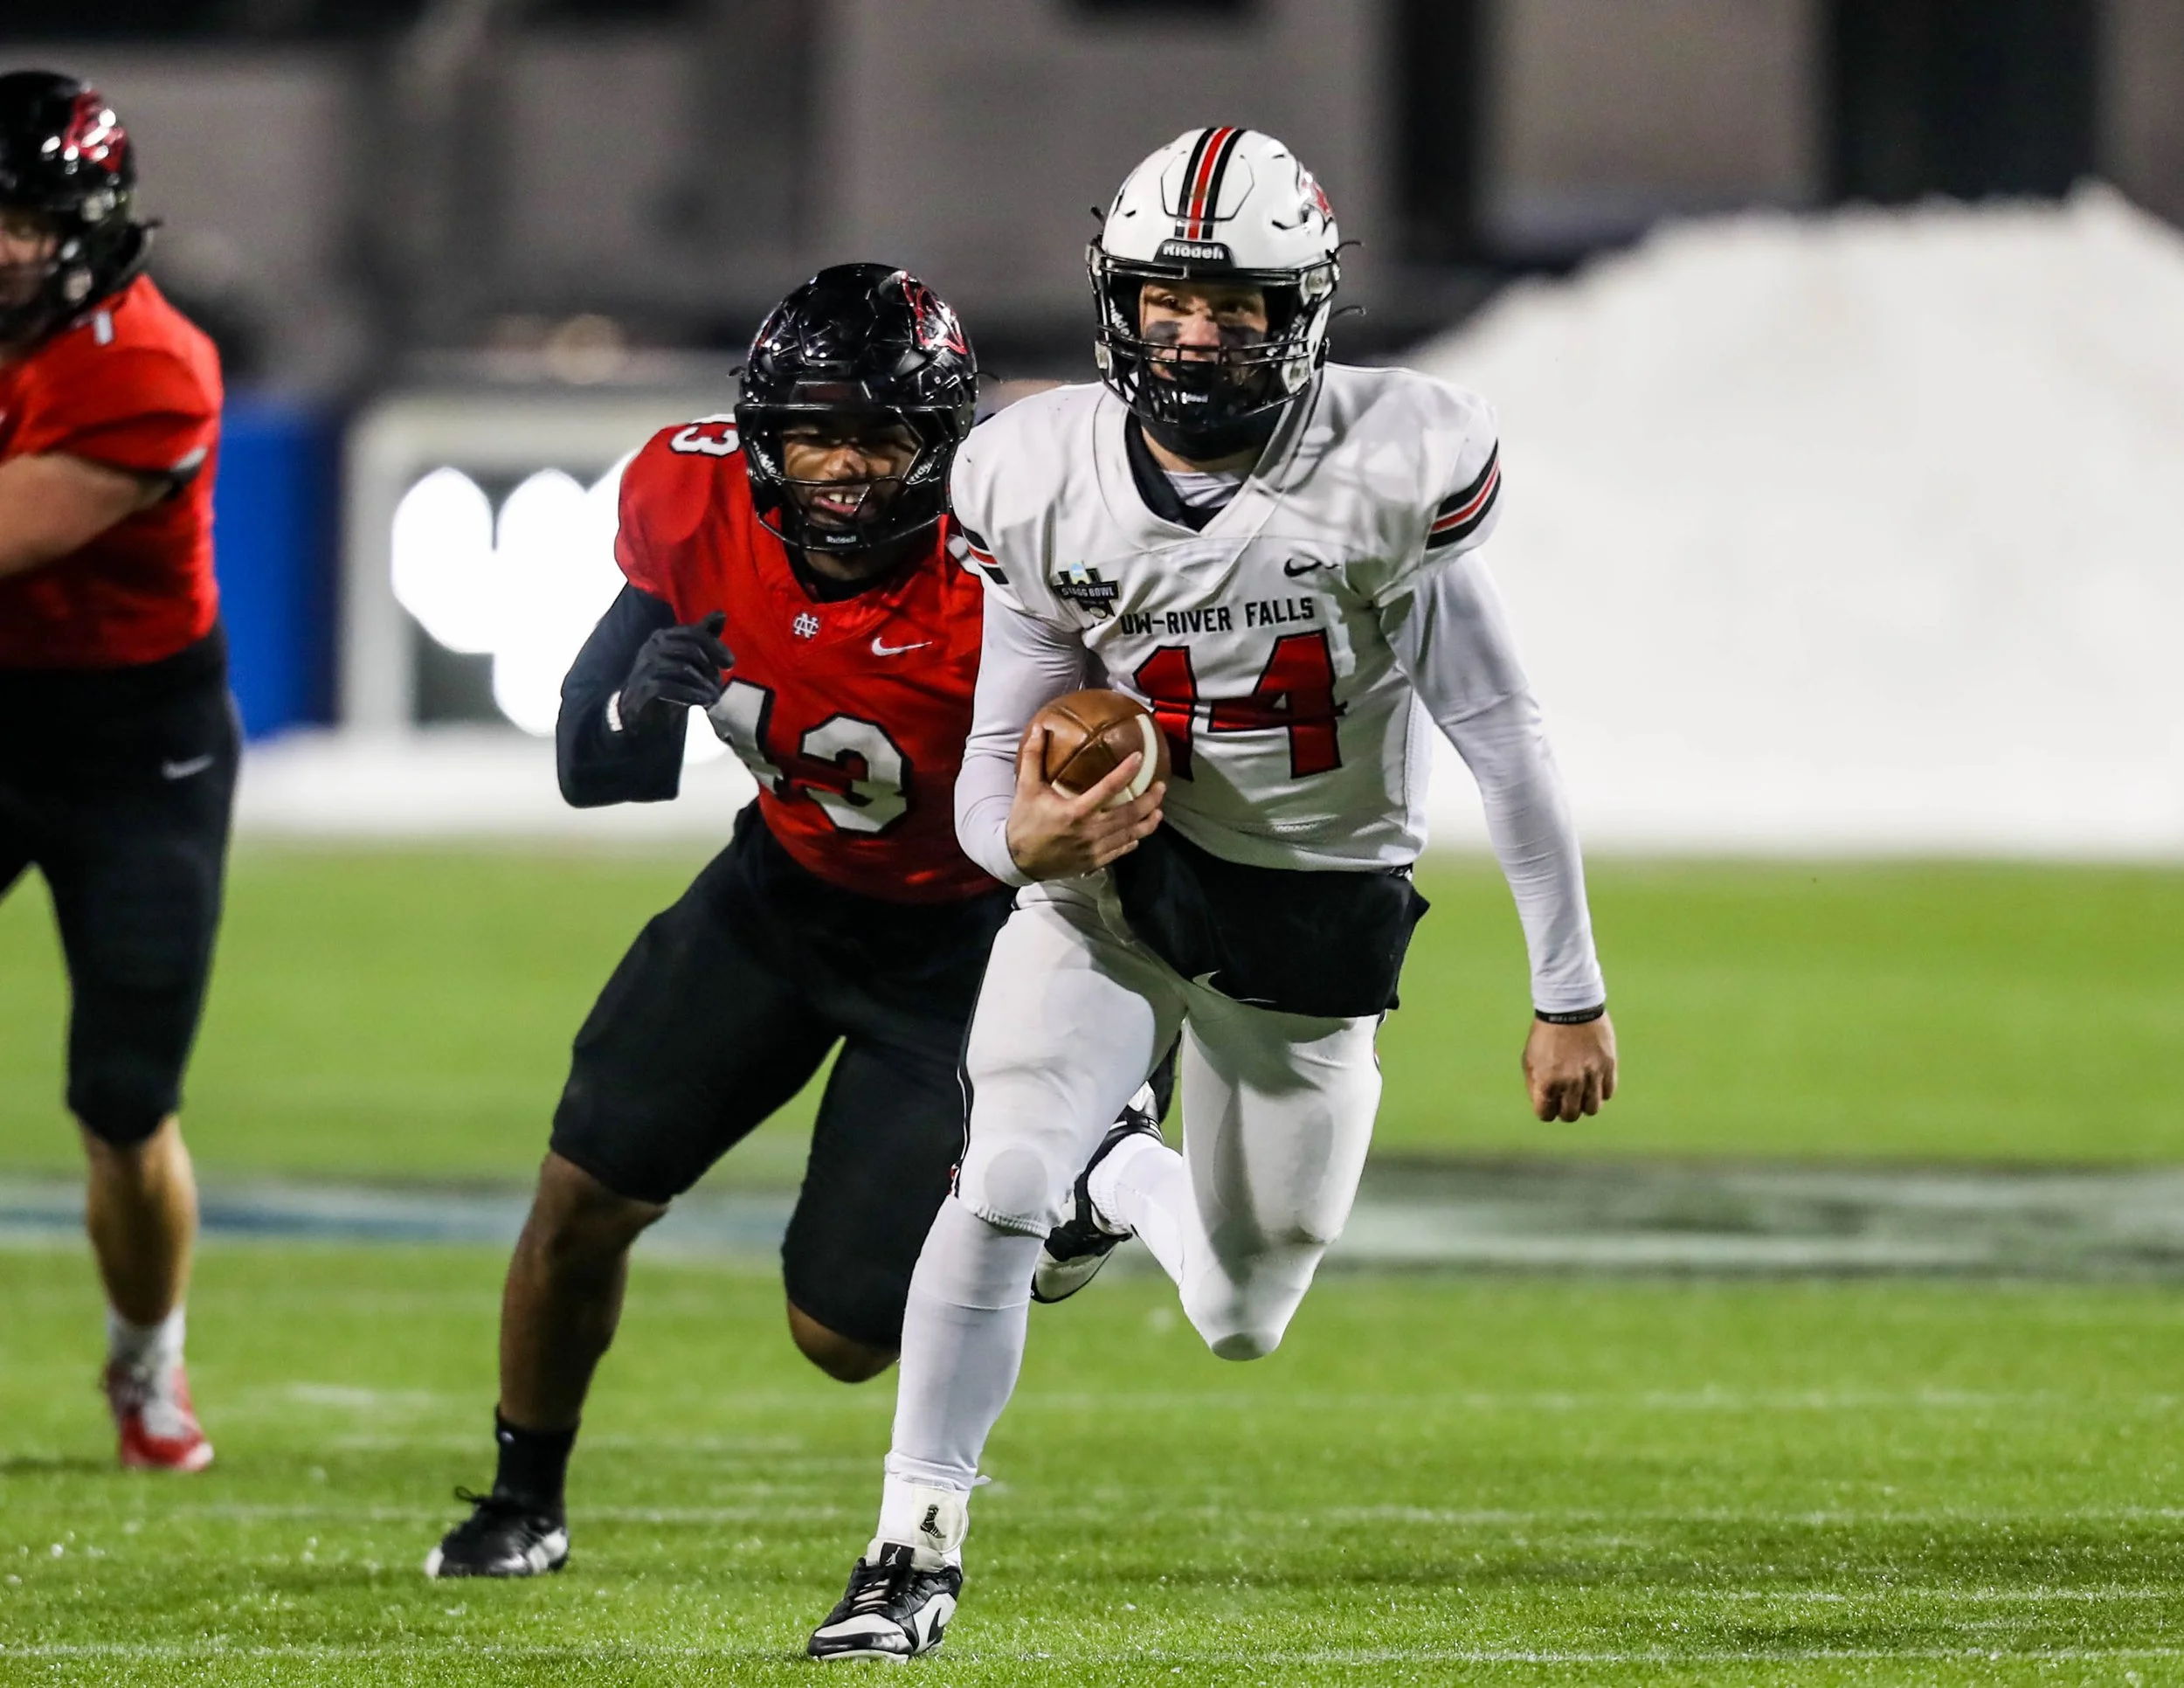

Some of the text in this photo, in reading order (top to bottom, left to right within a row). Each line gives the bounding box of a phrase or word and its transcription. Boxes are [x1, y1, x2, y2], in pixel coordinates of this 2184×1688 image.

[1088, 586, 1115, 598] BOWL
[1120, 597, 1315, 636] UW-RIVER FALLS
[1132, 628, 1346, 782] 14
